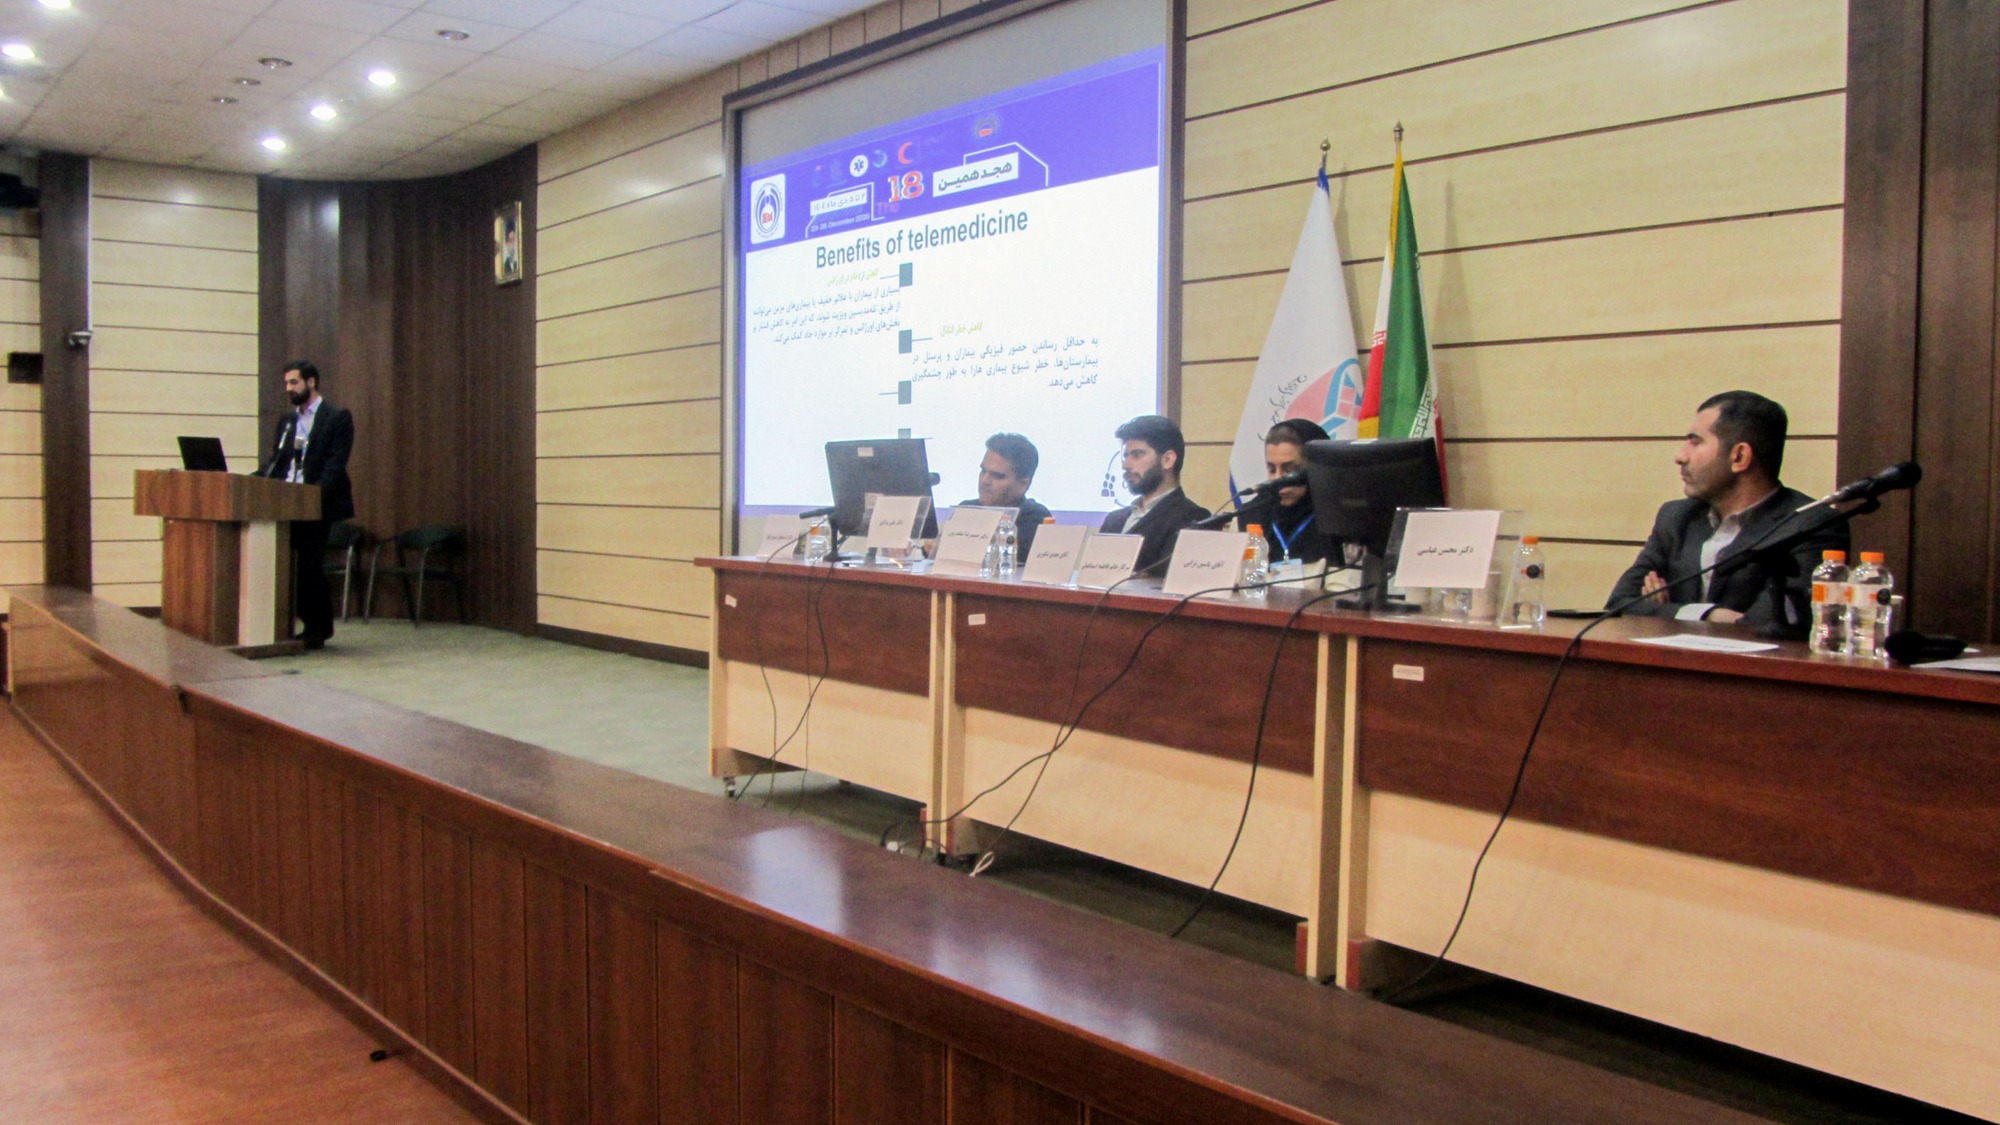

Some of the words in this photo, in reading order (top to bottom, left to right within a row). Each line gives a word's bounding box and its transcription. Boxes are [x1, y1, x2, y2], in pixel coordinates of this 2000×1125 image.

[938, 161, 1013, 192] هجدهمین
[887, 170, 924, 203] 18
[816, 238, 880, 268] Benefits
[886, 229, 903, 256] of
[908, 209, 1028, 252] telemedicine
[1008, 341, 1027, 355] حضور
[1032, 338, 1057, 354] رساندن
[1063, 335, 1085, 351] حداقل
[1091, 337, 1098, 348] به
[912, 352, 919, 364] در
[923, 351, 942, 364] پرسنل
[946, 351, 951, 361] و
[955, 346, 976, 361] بیماران
[980, 343, 1003, 359] فیزیکی
[945, 366, 957, 380] طور
[961, 367, 967, 378] به
[986, 362, 1007, 377] بیماری
[1011, 360, 1030, 375] شیوع
[1034, 358, 1049, 373] خطر
[912, 367, 942, 383] چشمگیری
[1076, 373, 1098, 389] کاهش
[1438, 547, 1457, 556] محسن
[1458, 545, 1474, 557] دکتر
